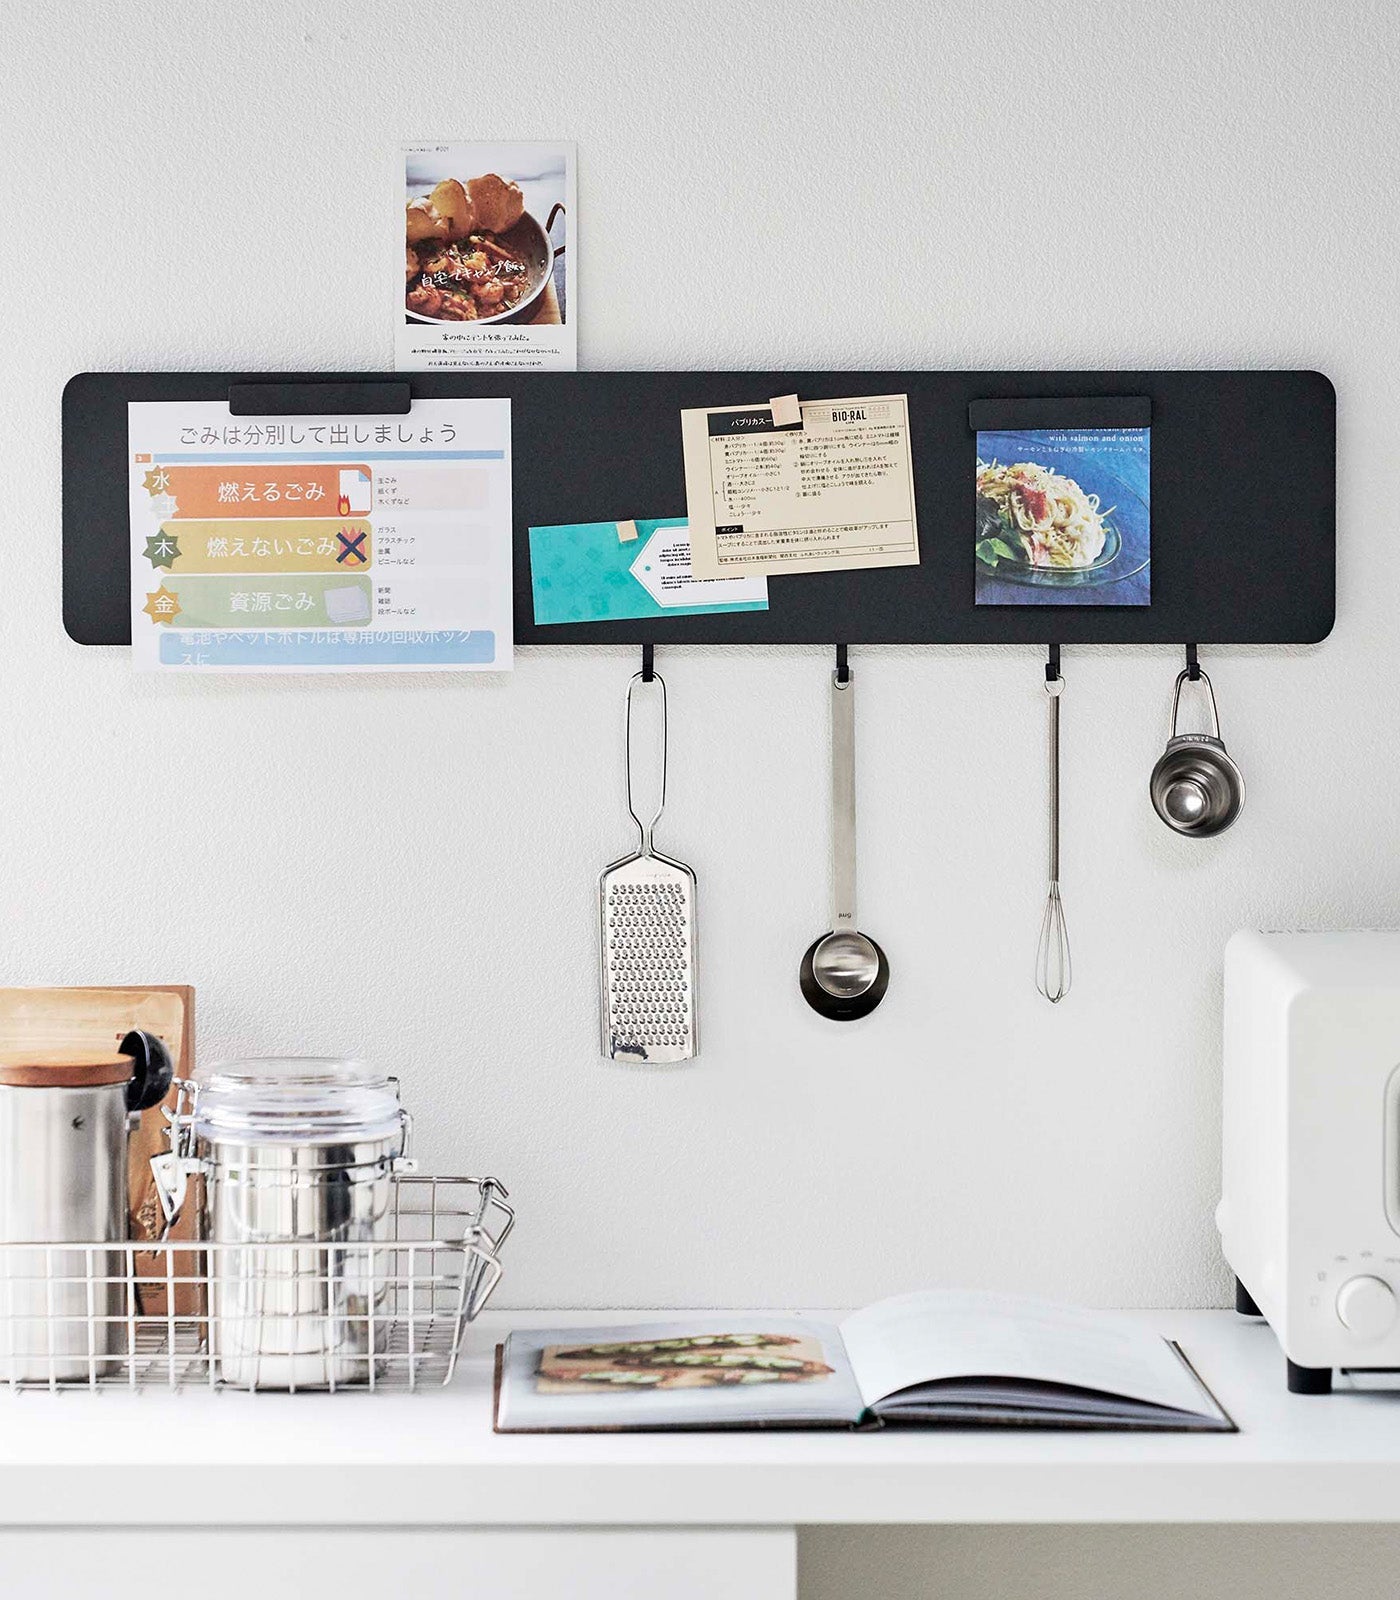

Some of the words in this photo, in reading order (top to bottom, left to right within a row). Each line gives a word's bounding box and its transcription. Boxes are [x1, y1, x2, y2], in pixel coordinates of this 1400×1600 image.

[180, 423, 456, 445] ごみは分別して出しましょう
[1048, 433, 1068, 442] with
[1070, 433, 1099, 442] salmon
[1101, 433, 1117, 442] and
[1119, 434, 1144, 442] onion
[152, 470, 170, 490] 水
[218, 481, 326, 502] 燃えるごみ
[154, 538, 174, 558] 木
[206, 537, 337, 558] 燃えないごみ
[154, 595, 174, 614] 金
[229, 591, 316, 613] 資源ごみ
